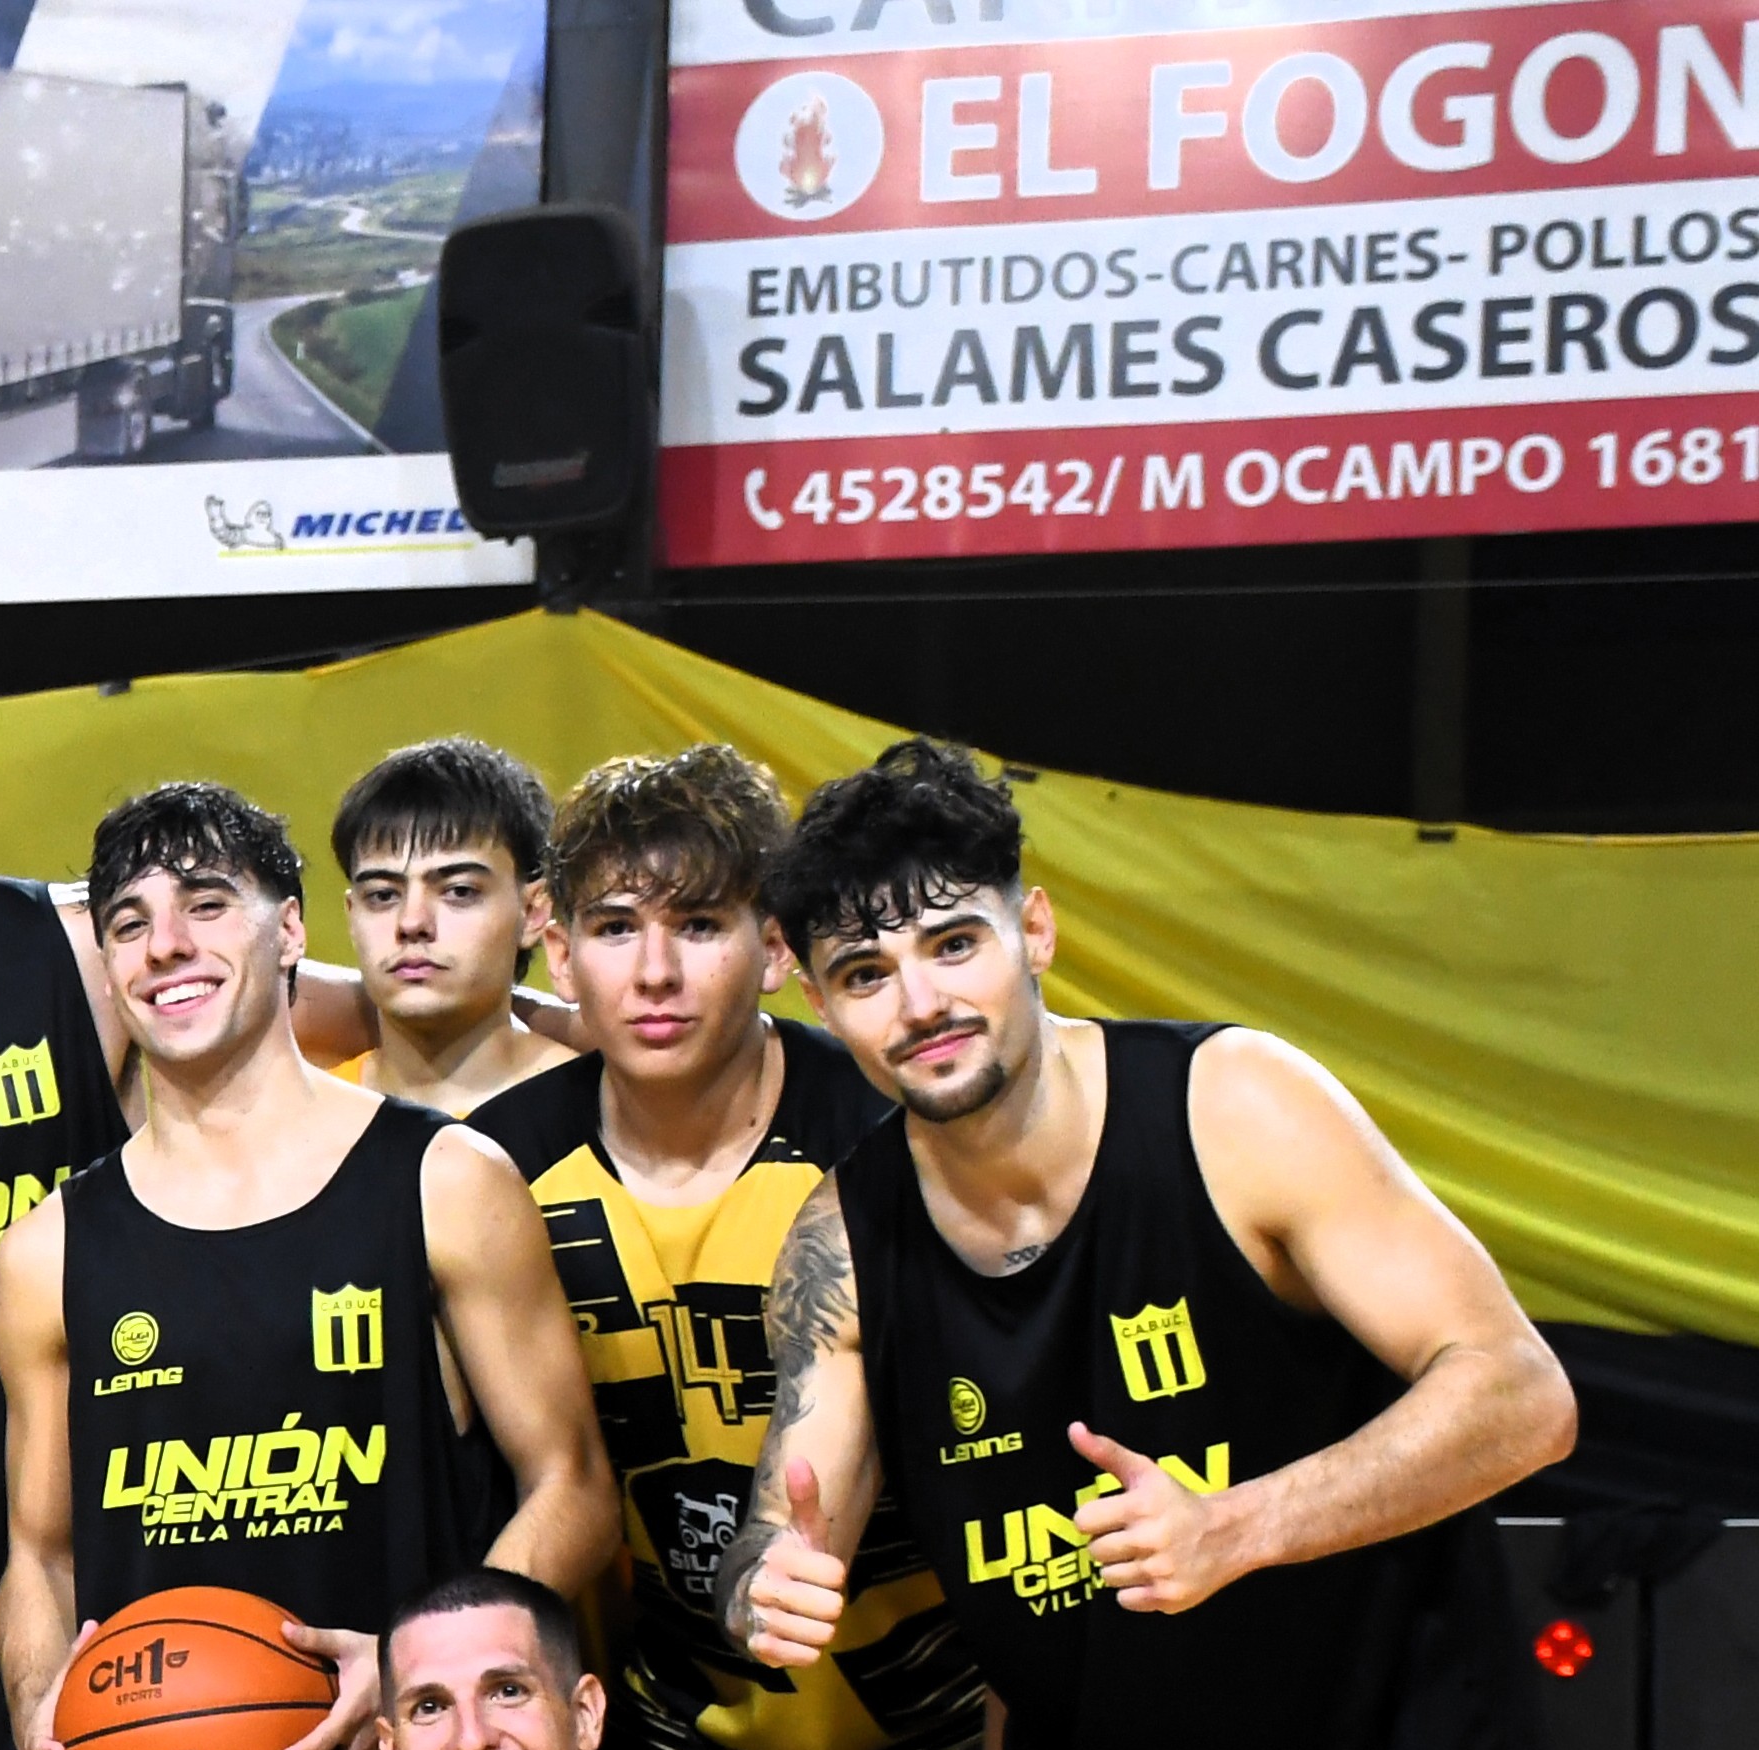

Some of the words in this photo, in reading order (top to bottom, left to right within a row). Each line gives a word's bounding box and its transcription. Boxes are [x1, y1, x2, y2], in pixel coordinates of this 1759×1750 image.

[920, 72, 1098, 203] EL
[1147, 22, 1759, 191] FOGON
[1489, 206, 1759, 277] POLLOS
[738, 315, 1225, 416] SALAMES
[1258, 281, 1759, 391] CASEROS
[792, 454, 1125, 527] 4528542/
[1138, 453, 1205, 513] M
[1223, 432, 1565, 510] OCAMPO
[1586, 424, 1759, 491] 1681
[94, 1366, 184, 1397] LENING
[102, 1412, 387, 1510] UNIÓN
[940, 1432, 1024, 1465] LENING
[141, 1480, 349, 1528] CENTRAL
[144, 1524, 229, 1547] VILLA
[245, 1514, 344, 1539] MARIA
[115, 1688, 163, 1706] SPORTS
